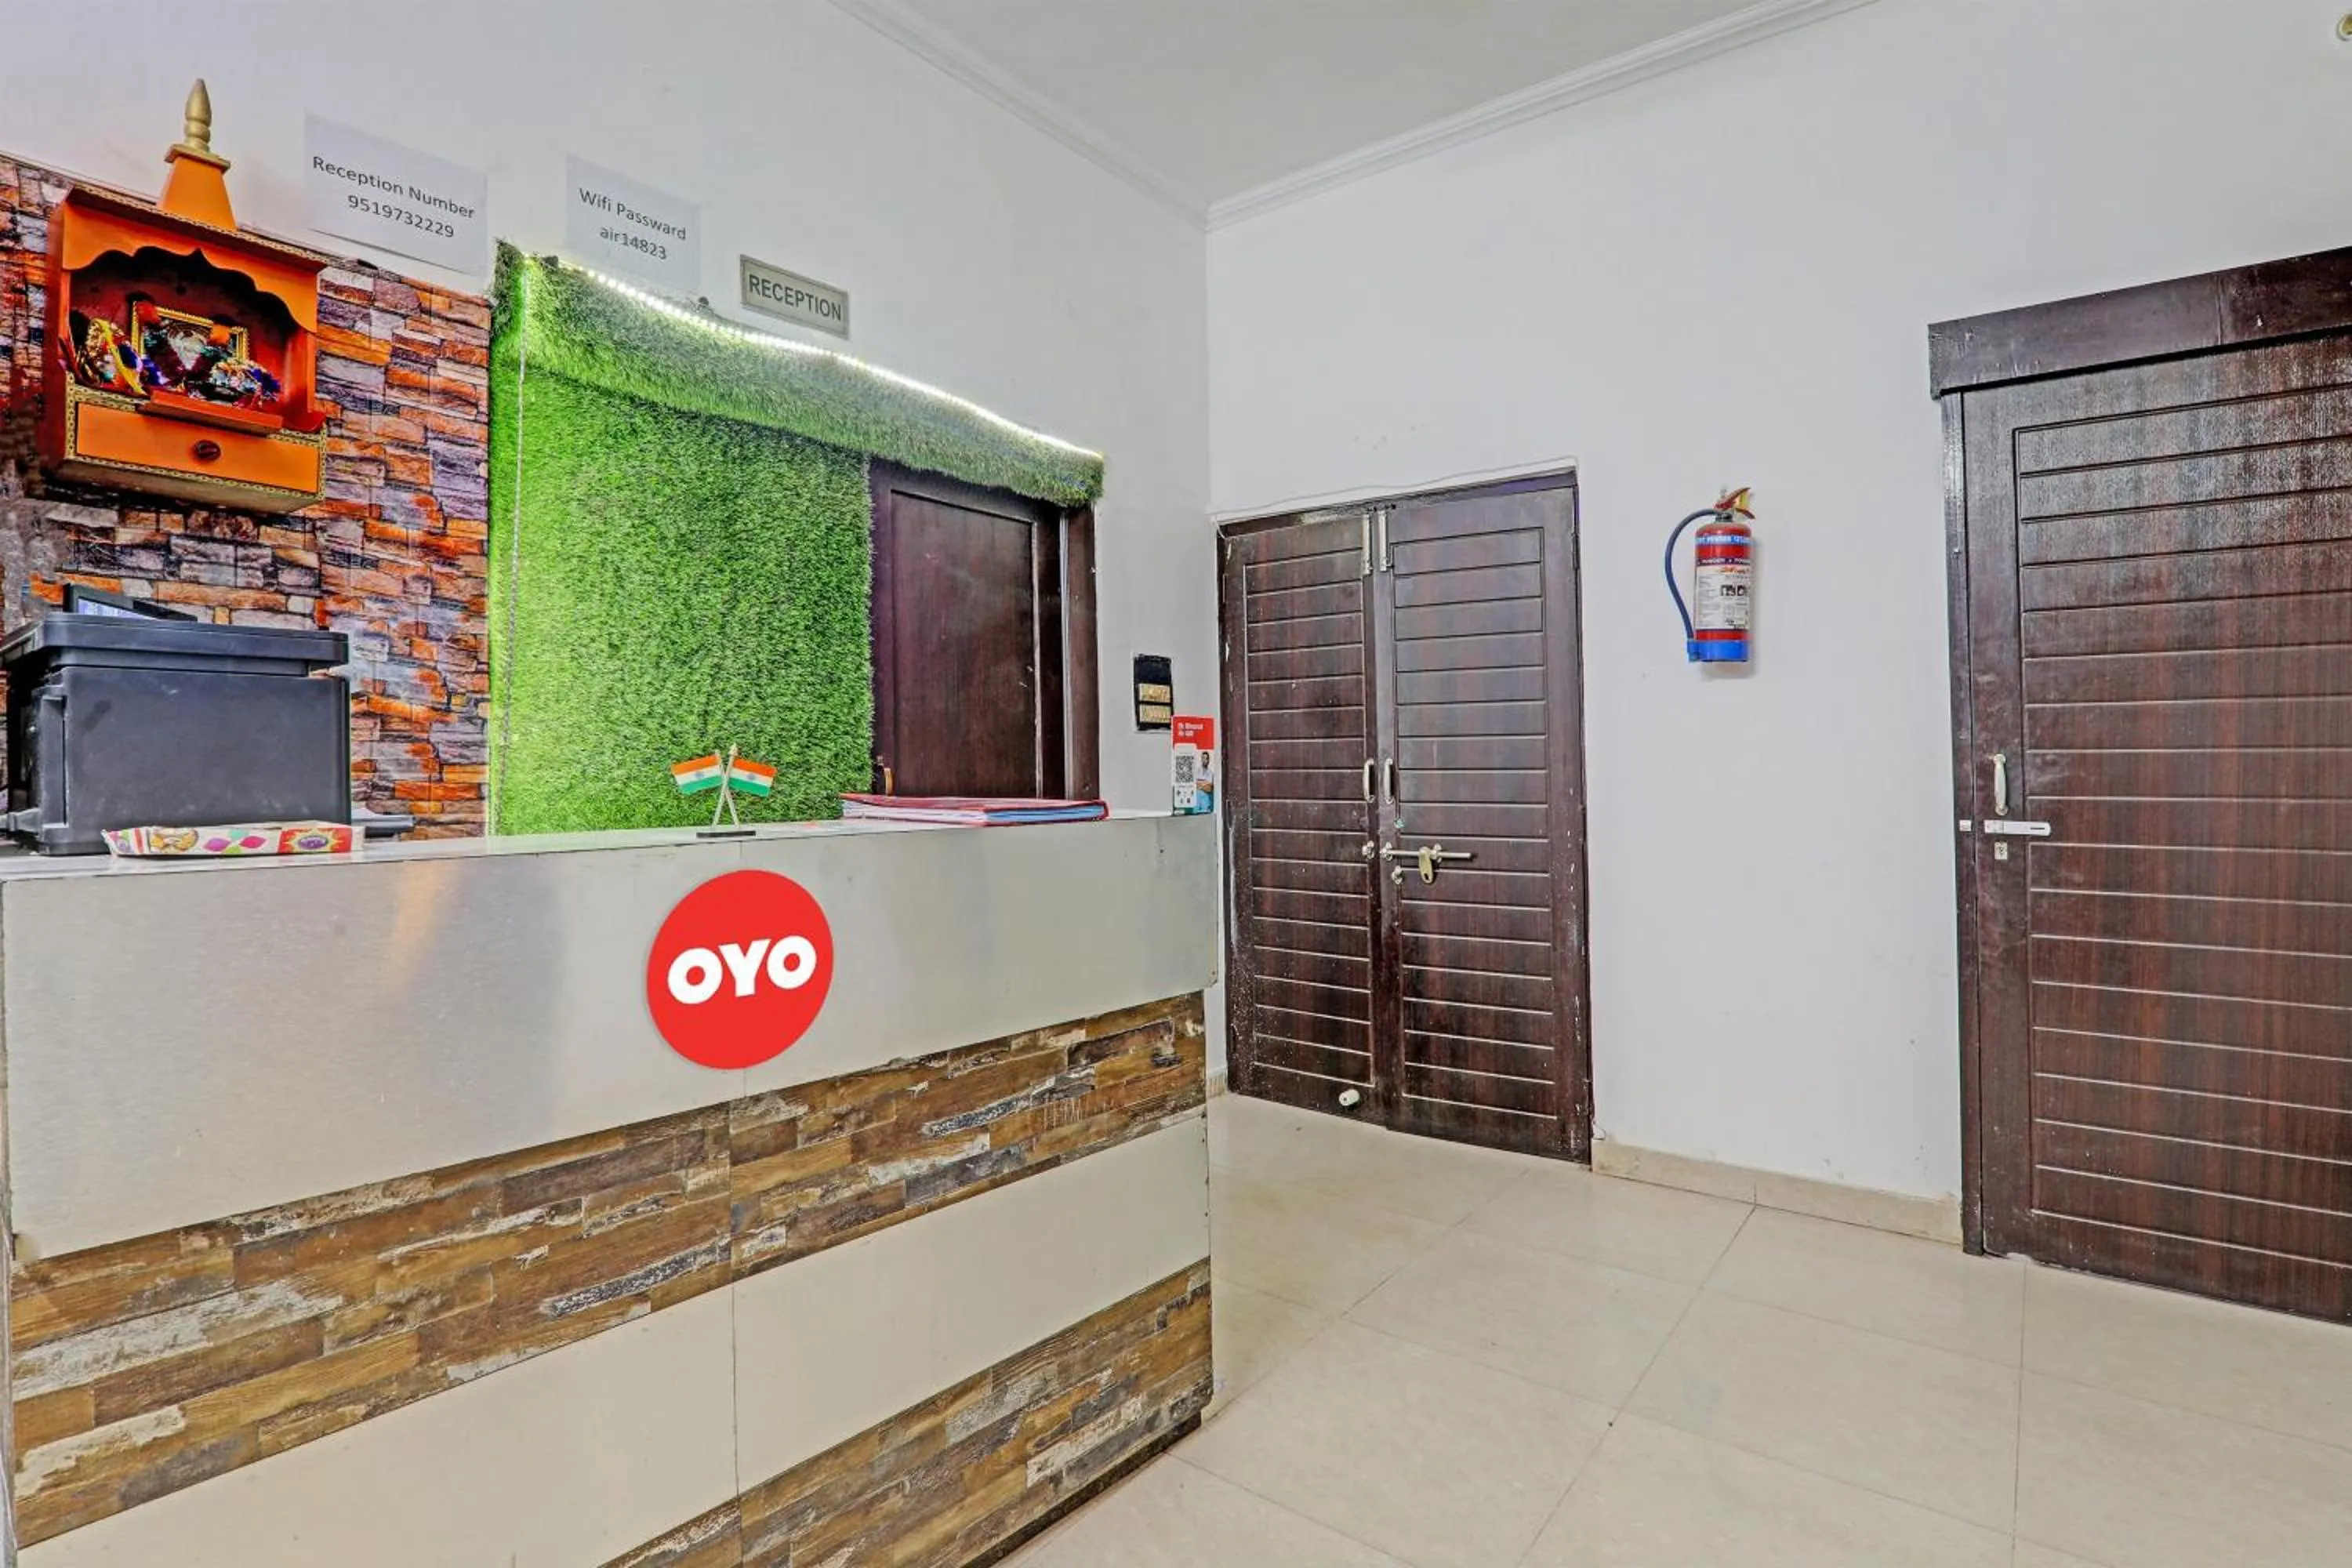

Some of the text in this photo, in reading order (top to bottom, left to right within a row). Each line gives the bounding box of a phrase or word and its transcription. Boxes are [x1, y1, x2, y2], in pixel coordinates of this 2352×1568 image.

[313, 156, 474, 219] Reception Number
[347, 194, 454, 238] 9519732229
[579, 187, 686, 240] Wifi Passward
[600, 227, 667, 260] air14823
[749, 273, 841, 321] RECEPTION
[667, 935, 817, 1004] OYO
